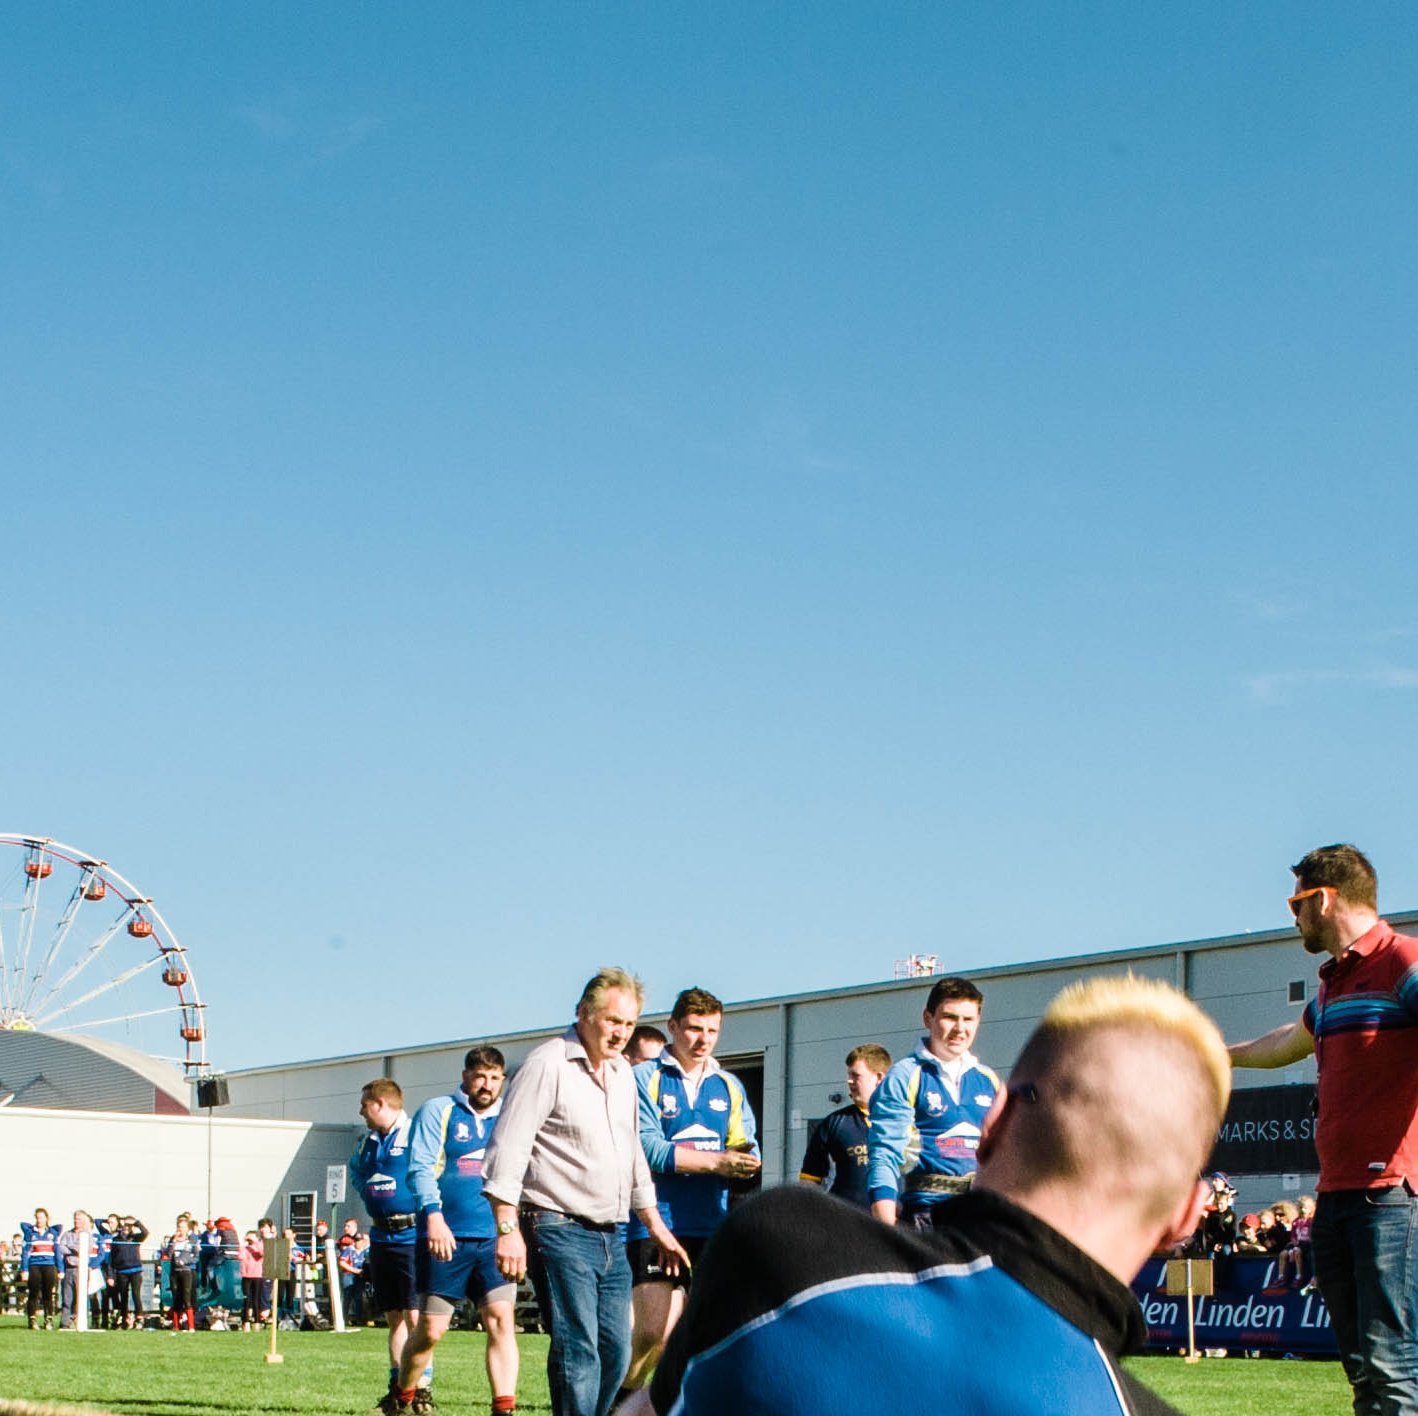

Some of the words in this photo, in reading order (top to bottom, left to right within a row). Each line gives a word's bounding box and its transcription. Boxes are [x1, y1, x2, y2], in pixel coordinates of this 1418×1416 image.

[1215, 1120, 1280, 1143] MARKS
[1283, 1119, 1296, 1140] &
[332, 1183, 339, 1198] 5
[1195, 1294, 1284, 1328] Linden
